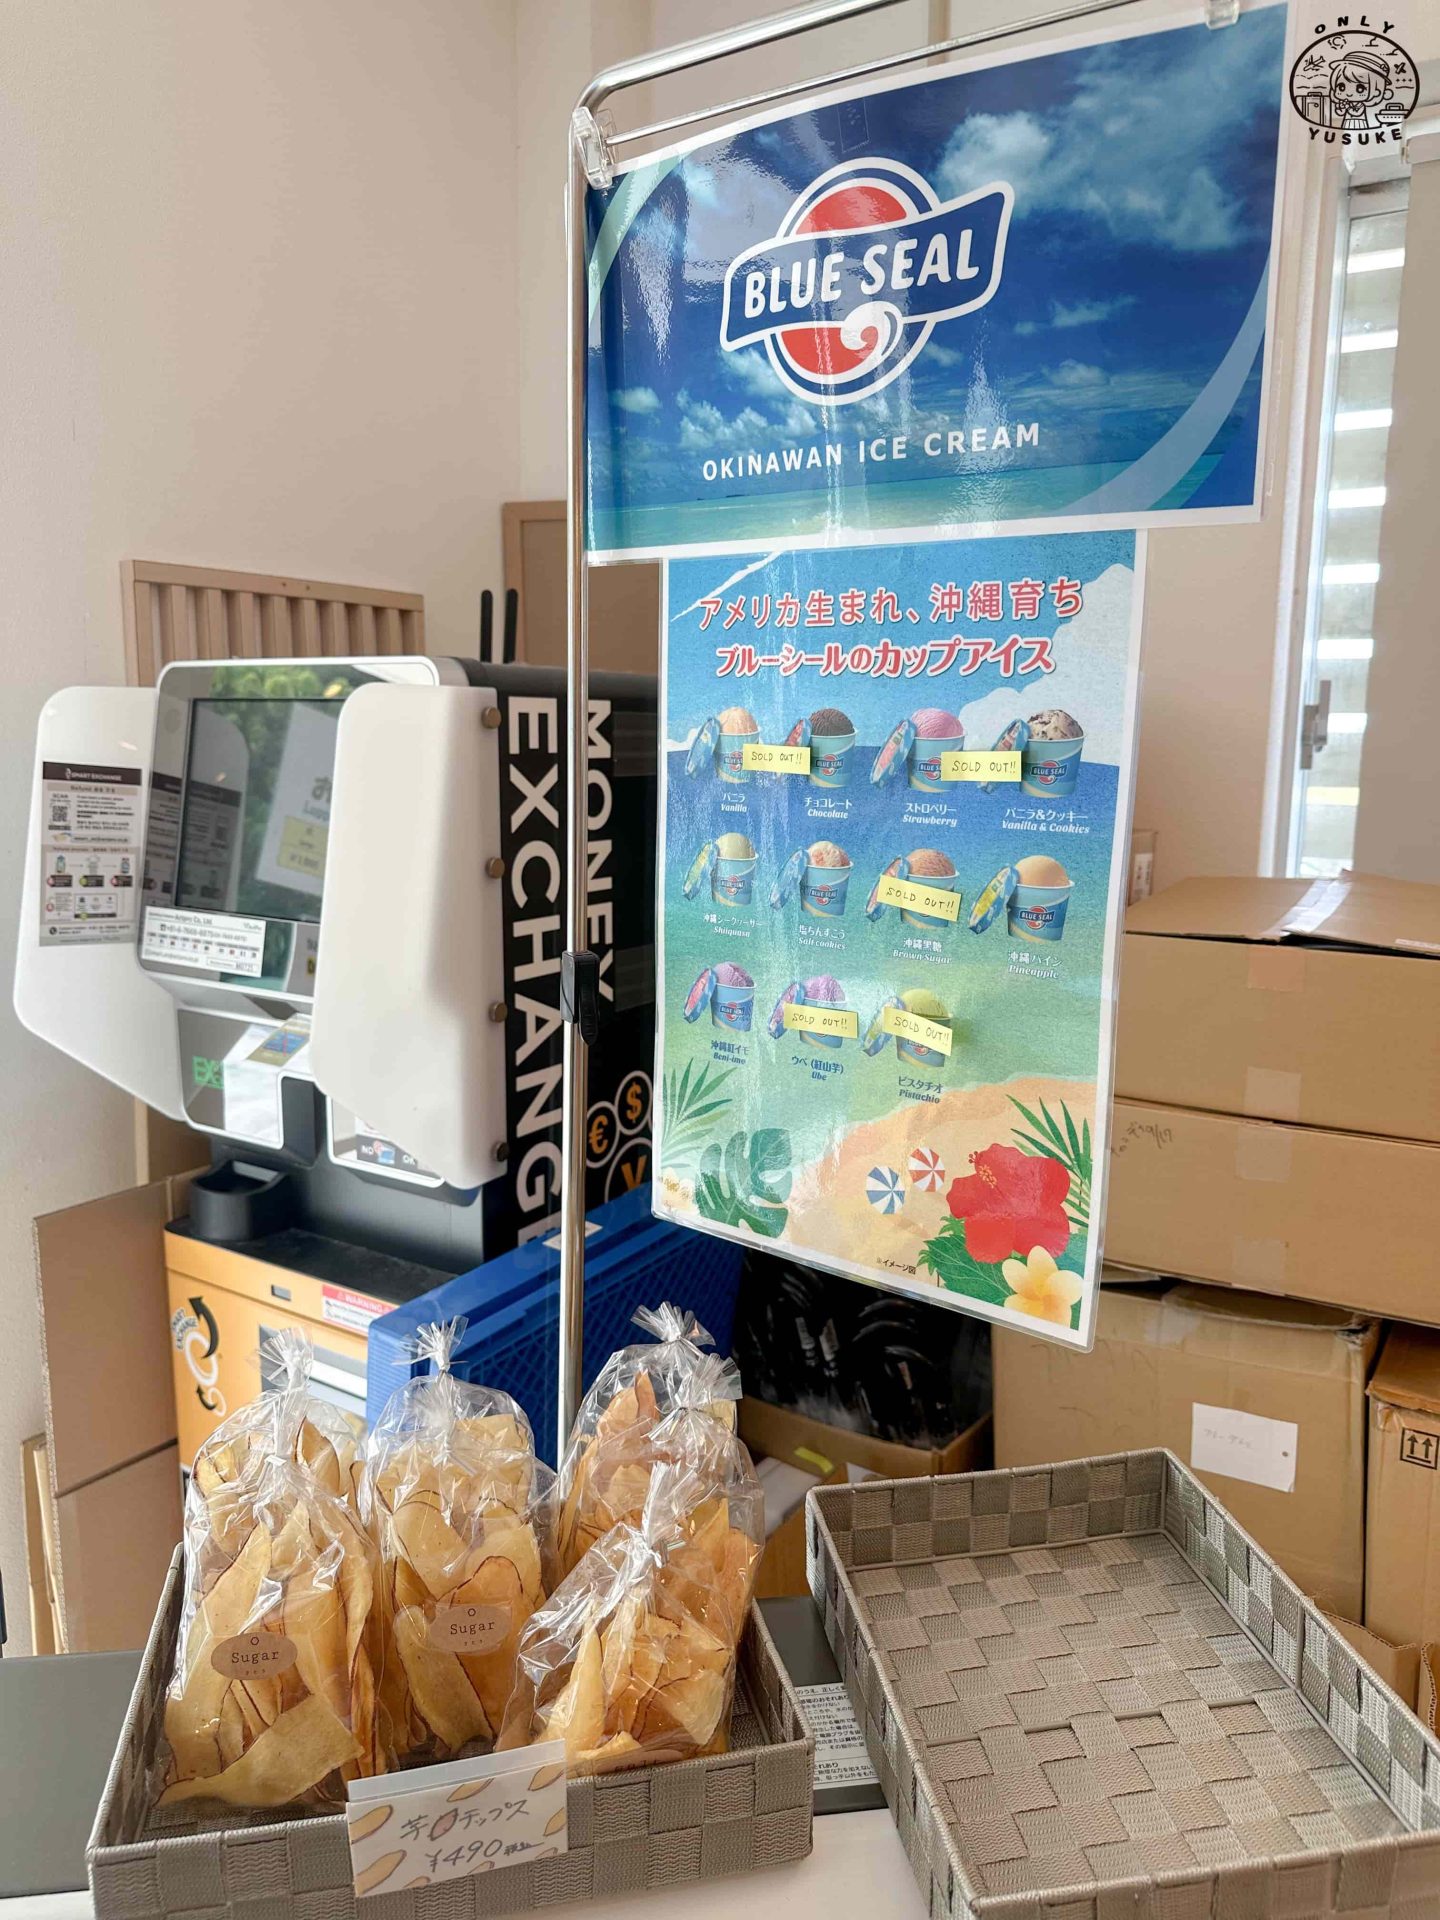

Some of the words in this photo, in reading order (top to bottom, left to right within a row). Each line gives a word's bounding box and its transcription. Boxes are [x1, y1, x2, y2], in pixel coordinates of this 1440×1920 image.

[744, 252, 844, 319] BLUE
[860, 228, 979, 296] SEAL
[702, 443, 842, 481] OKINAWAN
[859, 436, 907, 463] ICE
[924, 423, 1039, 457] CREAM
[699, 576, 1084, 630] アメリカ生まれ、沖縄育ち
[716, 635, 1056, 679] ブルーシールのカップアイス
[751, 751, 774, 762] SOLD
[952, 760, 981, 773] SOLD
[723, 792, 746, 802] バニラ
[804, 797, 852, 810] チョコレート
[721, 803, 747, 813] Vanilla
[808, 808, 849, 819] Chocolate
[905, 802, 957, 815] ストロベリー
[902, 814, 957, 828] Strawberry
[1002, 820, 1038, 832] Vanilla
[1039, 823, 1048, 832] &
[1049, 823, 1090, 835] Cookies
[886, 887, 917, 902] SOLD
[1020, 912, 1036, 920] BLUE
[1037, 912, 1053, 920] SEAL
[893, 949, 924, 961] Brown
[924, 953, 951, 965] Sugar
[1008, 964, 1059, 979] Pineapple
[792, 1013, 815, 1025] SOLD
[893, 1016, 920, 1033] SOLD
[811, 1072, 828, 1081] Ube
[899, 1089, 941, 1104] Pistachio
[450, 1621, 495, 1635] Sugar
[231, 1651, 279, 1664] Sugar
